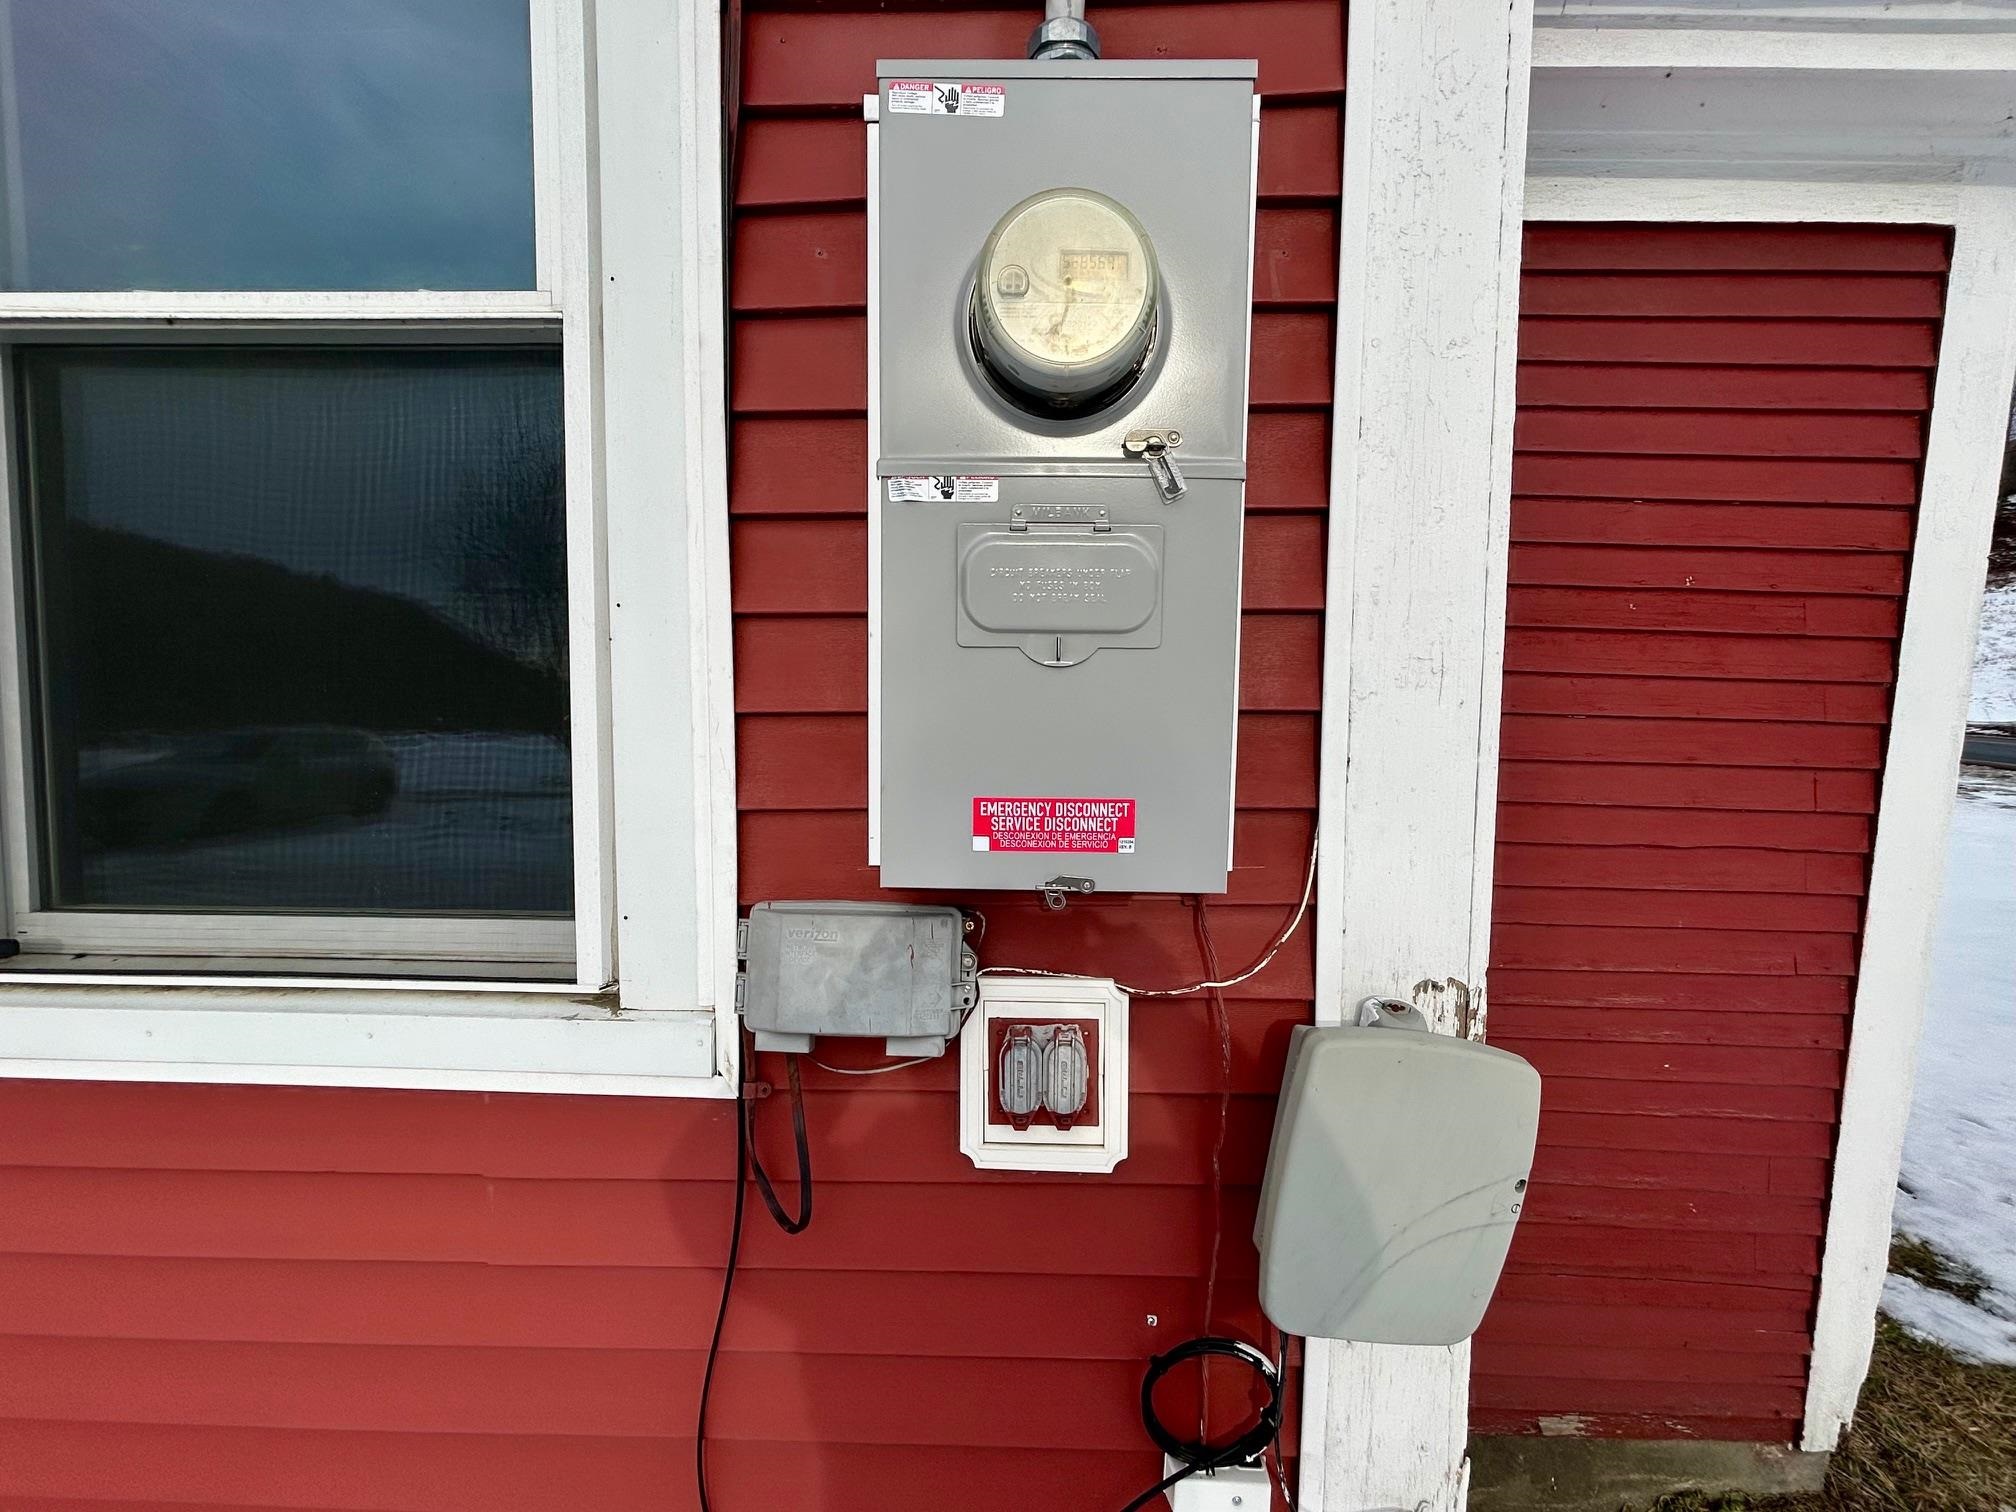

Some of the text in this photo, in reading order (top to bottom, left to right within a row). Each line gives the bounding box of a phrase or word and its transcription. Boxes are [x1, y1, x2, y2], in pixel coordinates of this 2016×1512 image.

[900, 83, 930, 91] DANGER
[972, 86, 1002, 95] PELIGRO
[980, 801, 1130, 818] EMERGENCY DISCONNECT
[990, 816, 1118, 832] SERVICE DISCONNECT
[992, 832, 1117, 841] DESCONEXION DE EMERGENCIA
[999, 840, 1057, 849] DESCONEXION
[1058, 840, 1070, 849] DE
[1071, 841, 1109, 850] SERVICIO
[788, 927, 839, 942] verizon
